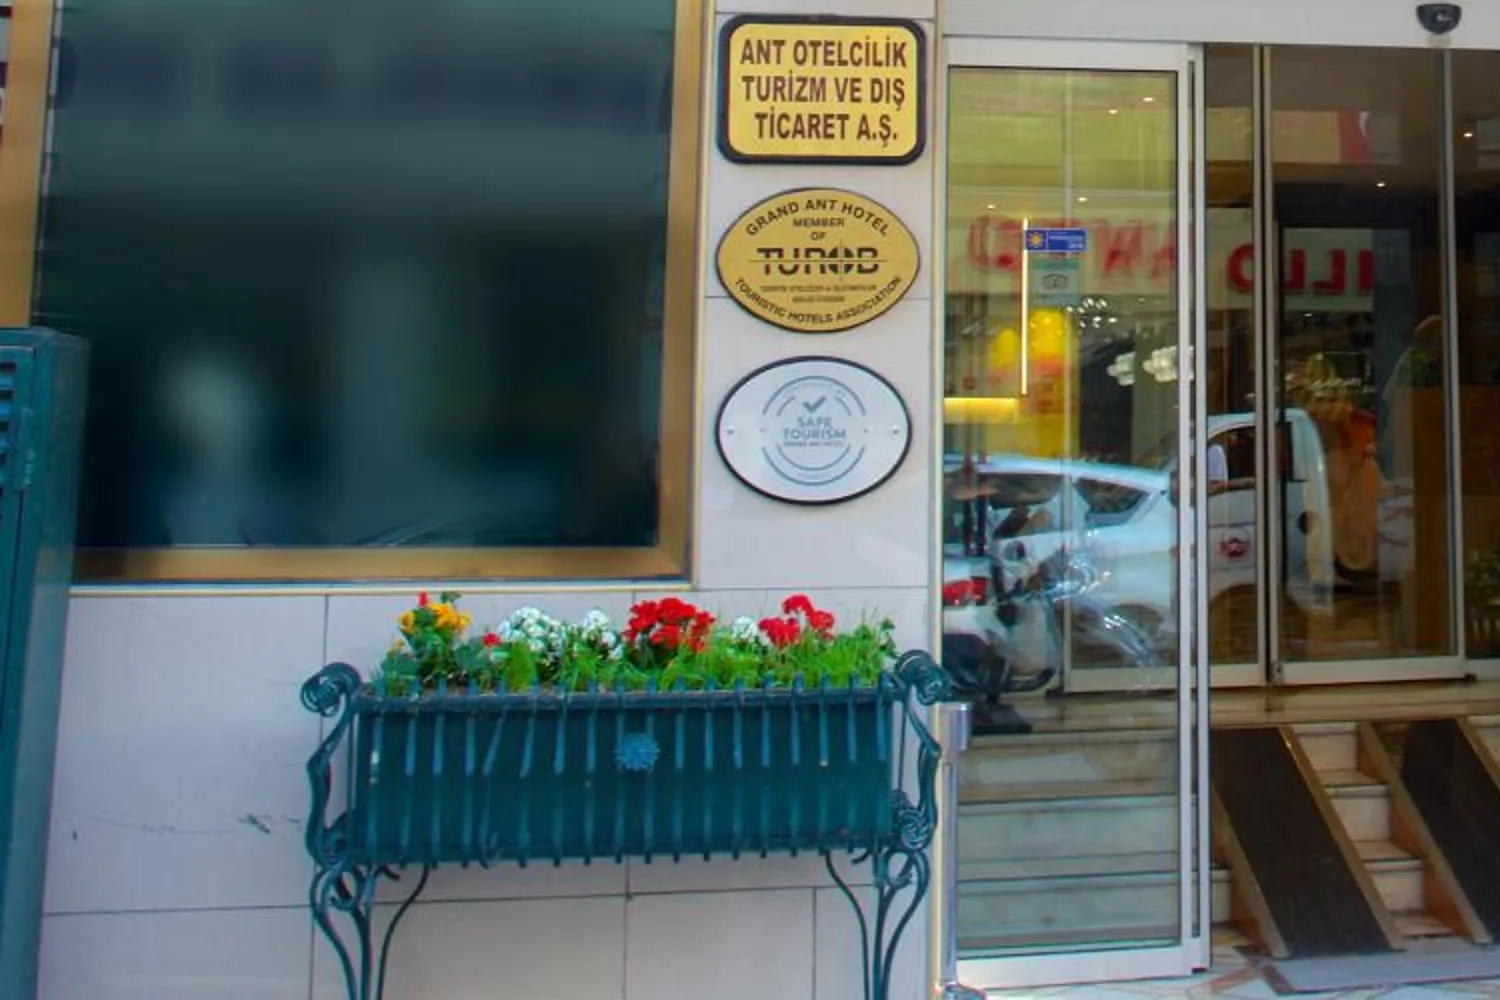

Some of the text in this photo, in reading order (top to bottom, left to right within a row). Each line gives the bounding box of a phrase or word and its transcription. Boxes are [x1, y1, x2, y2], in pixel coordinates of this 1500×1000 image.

[740, 35, 908, 67] ANT OTELCİLİK
[741, 70, 905, 111] TURİZM VE DIŞ
[755, 107, 897, 147] TİCARET A.Ş.
[745, 199, 890, 237] GRAND ANT HOTEL
[792, 217, 845, 227] MEMBER
[810, 231, 827, 240] OF
[735, 276, 902, 323] TOURISTIC HOTELS ASSOCIATION
[784, 427, 846, 439] TOURISM
[797, 416, 832, 427] SAFE
